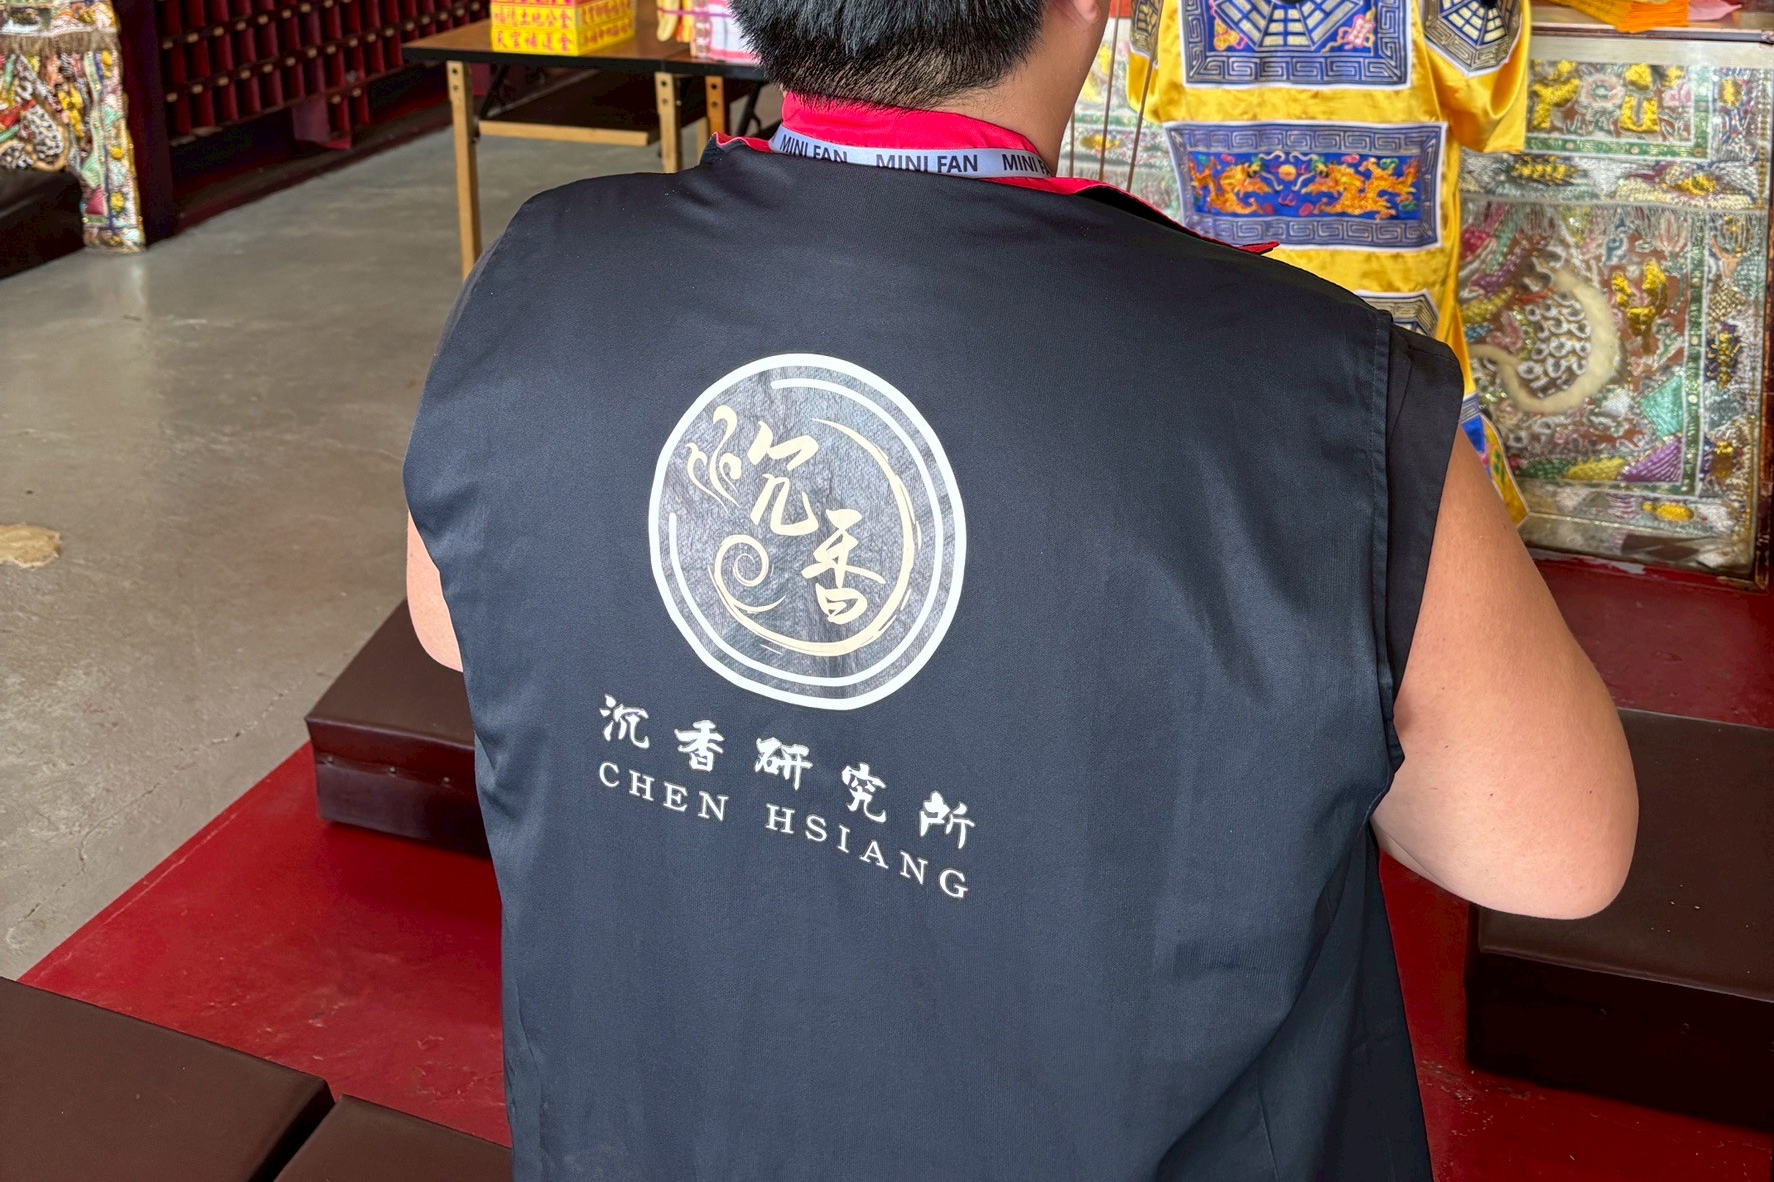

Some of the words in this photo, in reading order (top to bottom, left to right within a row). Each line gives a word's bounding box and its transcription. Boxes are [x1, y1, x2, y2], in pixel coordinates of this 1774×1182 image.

[780, 133, 809, 157] MINI
[875, 154, 928, 172] MINI
[937, 155, 978, 174] FAN
[1001, 154, 1039, 173] MINI
[599, 693, 975, 850] 沉香研究所
[599, 762, 729, 822] CHEN
[765, 803, 969, 899] HSIANG
